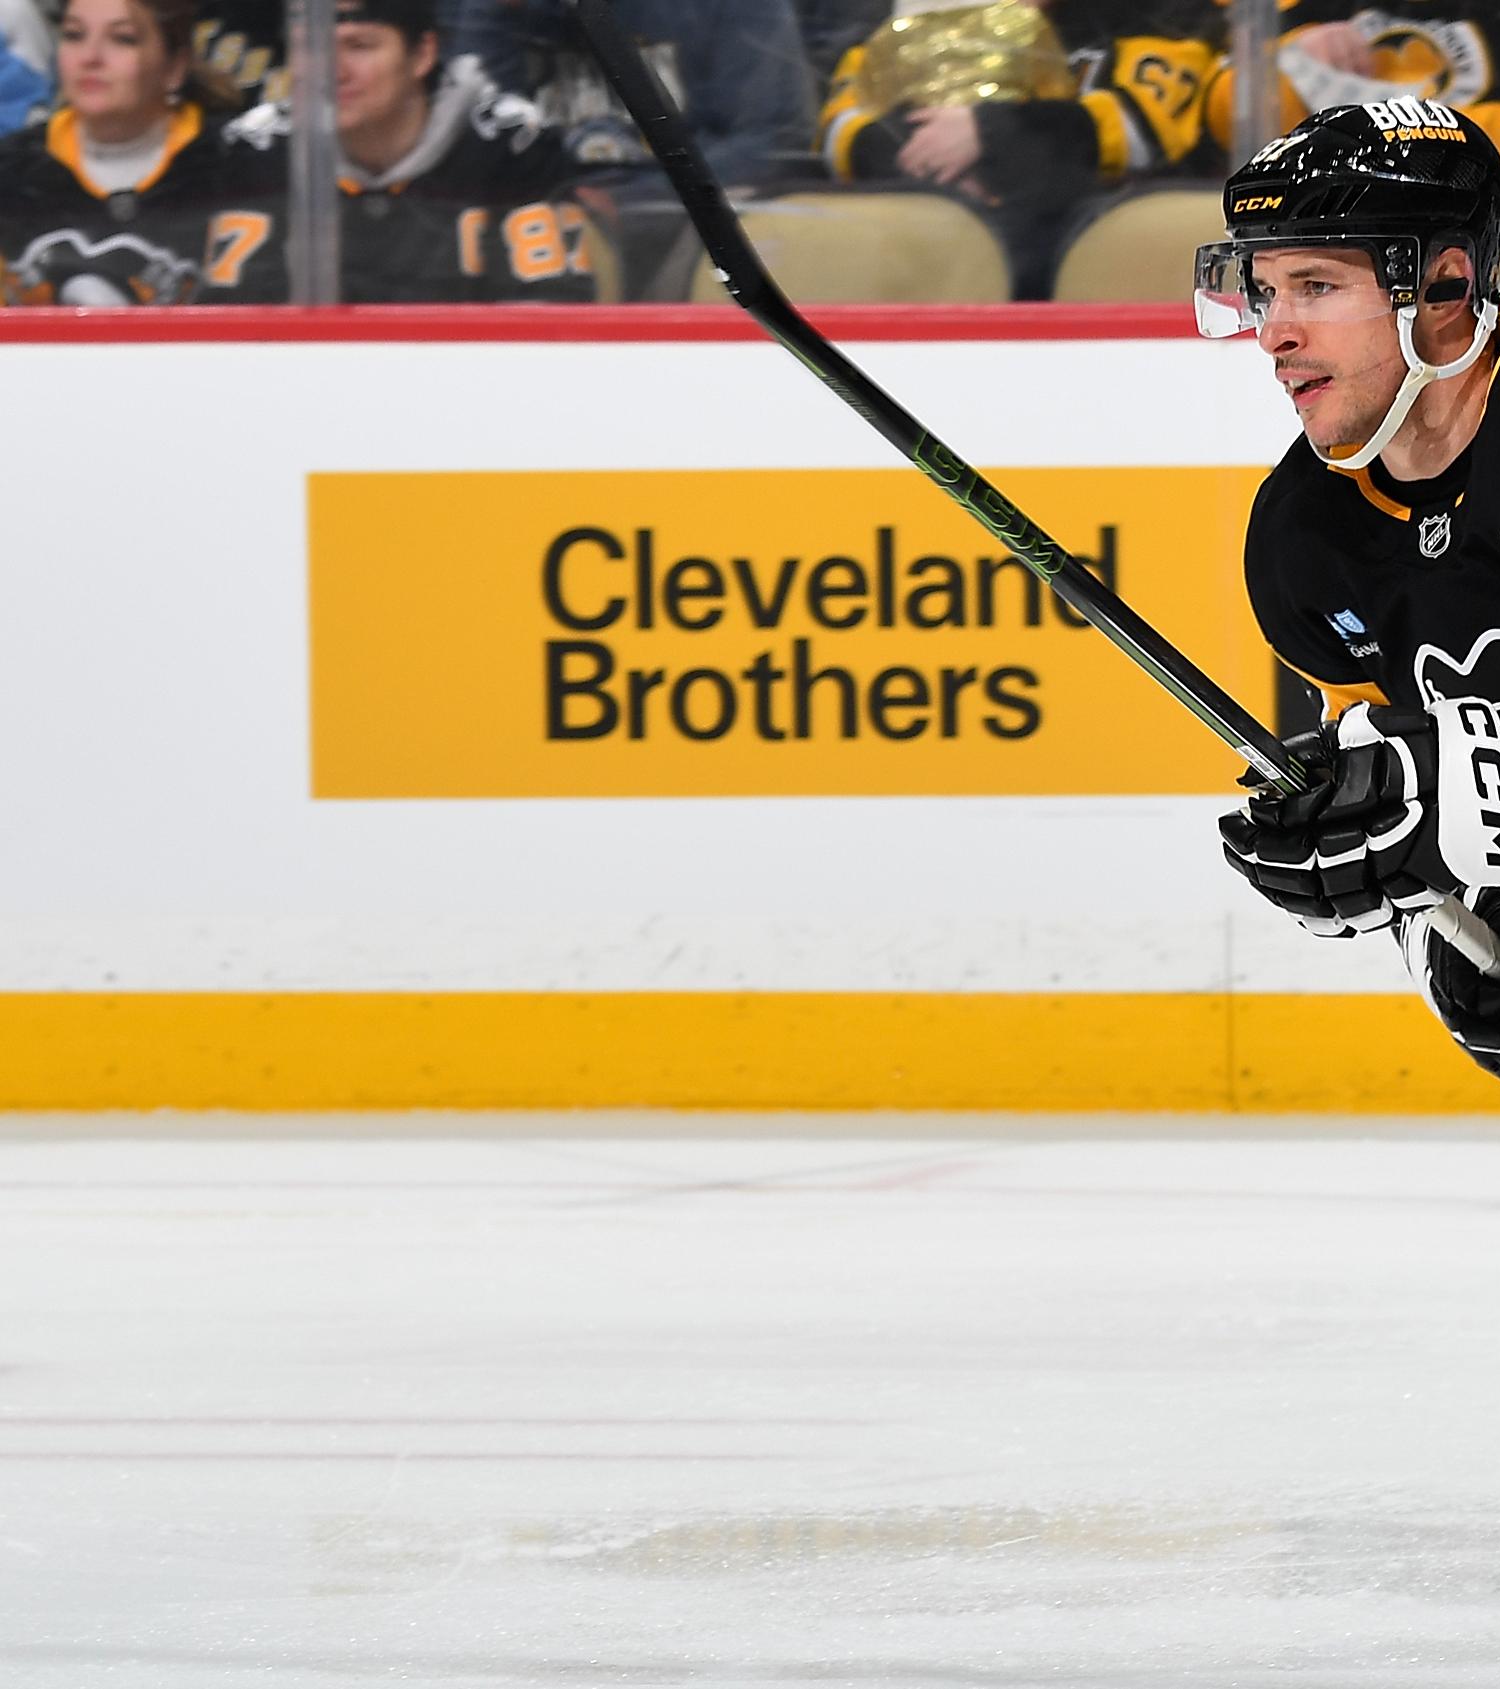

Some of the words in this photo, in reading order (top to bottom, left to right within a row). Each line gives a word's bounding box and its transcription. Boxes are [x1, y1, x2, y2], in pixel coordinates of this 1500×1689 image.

[1362, 94, 1460, 131] BOLD
[1382, 127, 1467, 144] PENGUIN
[1233, 196, 1283, 214] CCM
[542, 525, 1119, 631] Cleveland
[543, 637, 1044, 743] Brothers
